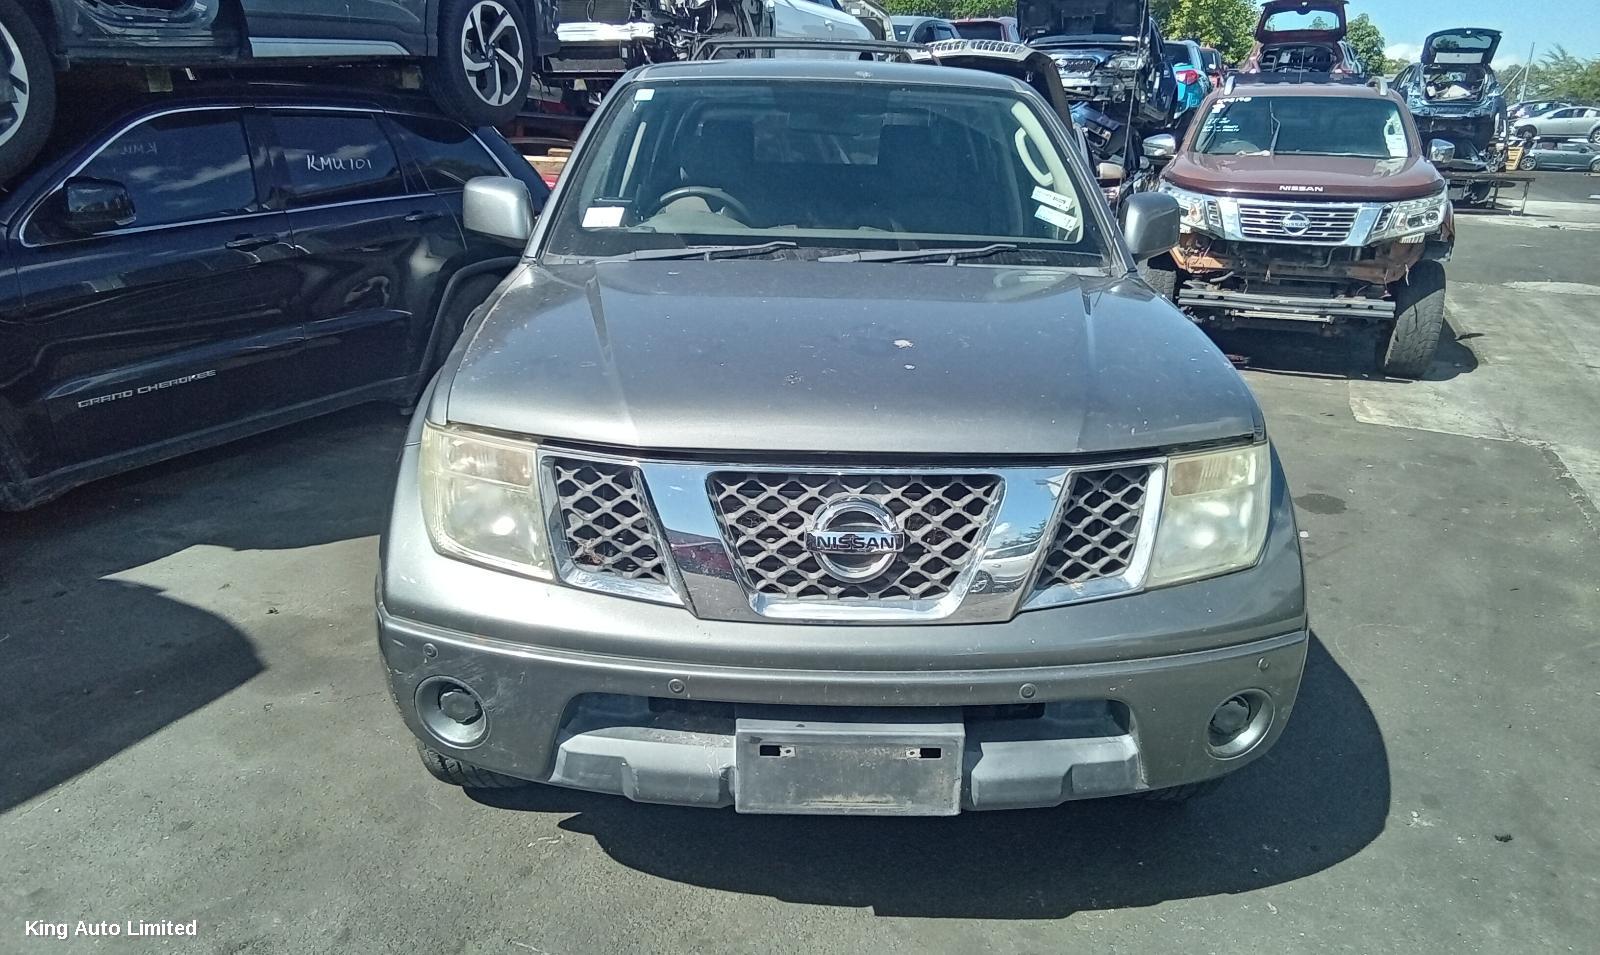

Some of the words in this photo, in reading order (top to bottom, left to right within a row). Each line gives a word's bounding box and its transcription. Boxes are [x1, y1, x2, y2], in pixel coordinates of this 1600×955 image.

[77, 389, 133, 408] GRAND
[137, 369, 216, 394] CHEROKEE
[816, 535, 895, 549] NISSAN
